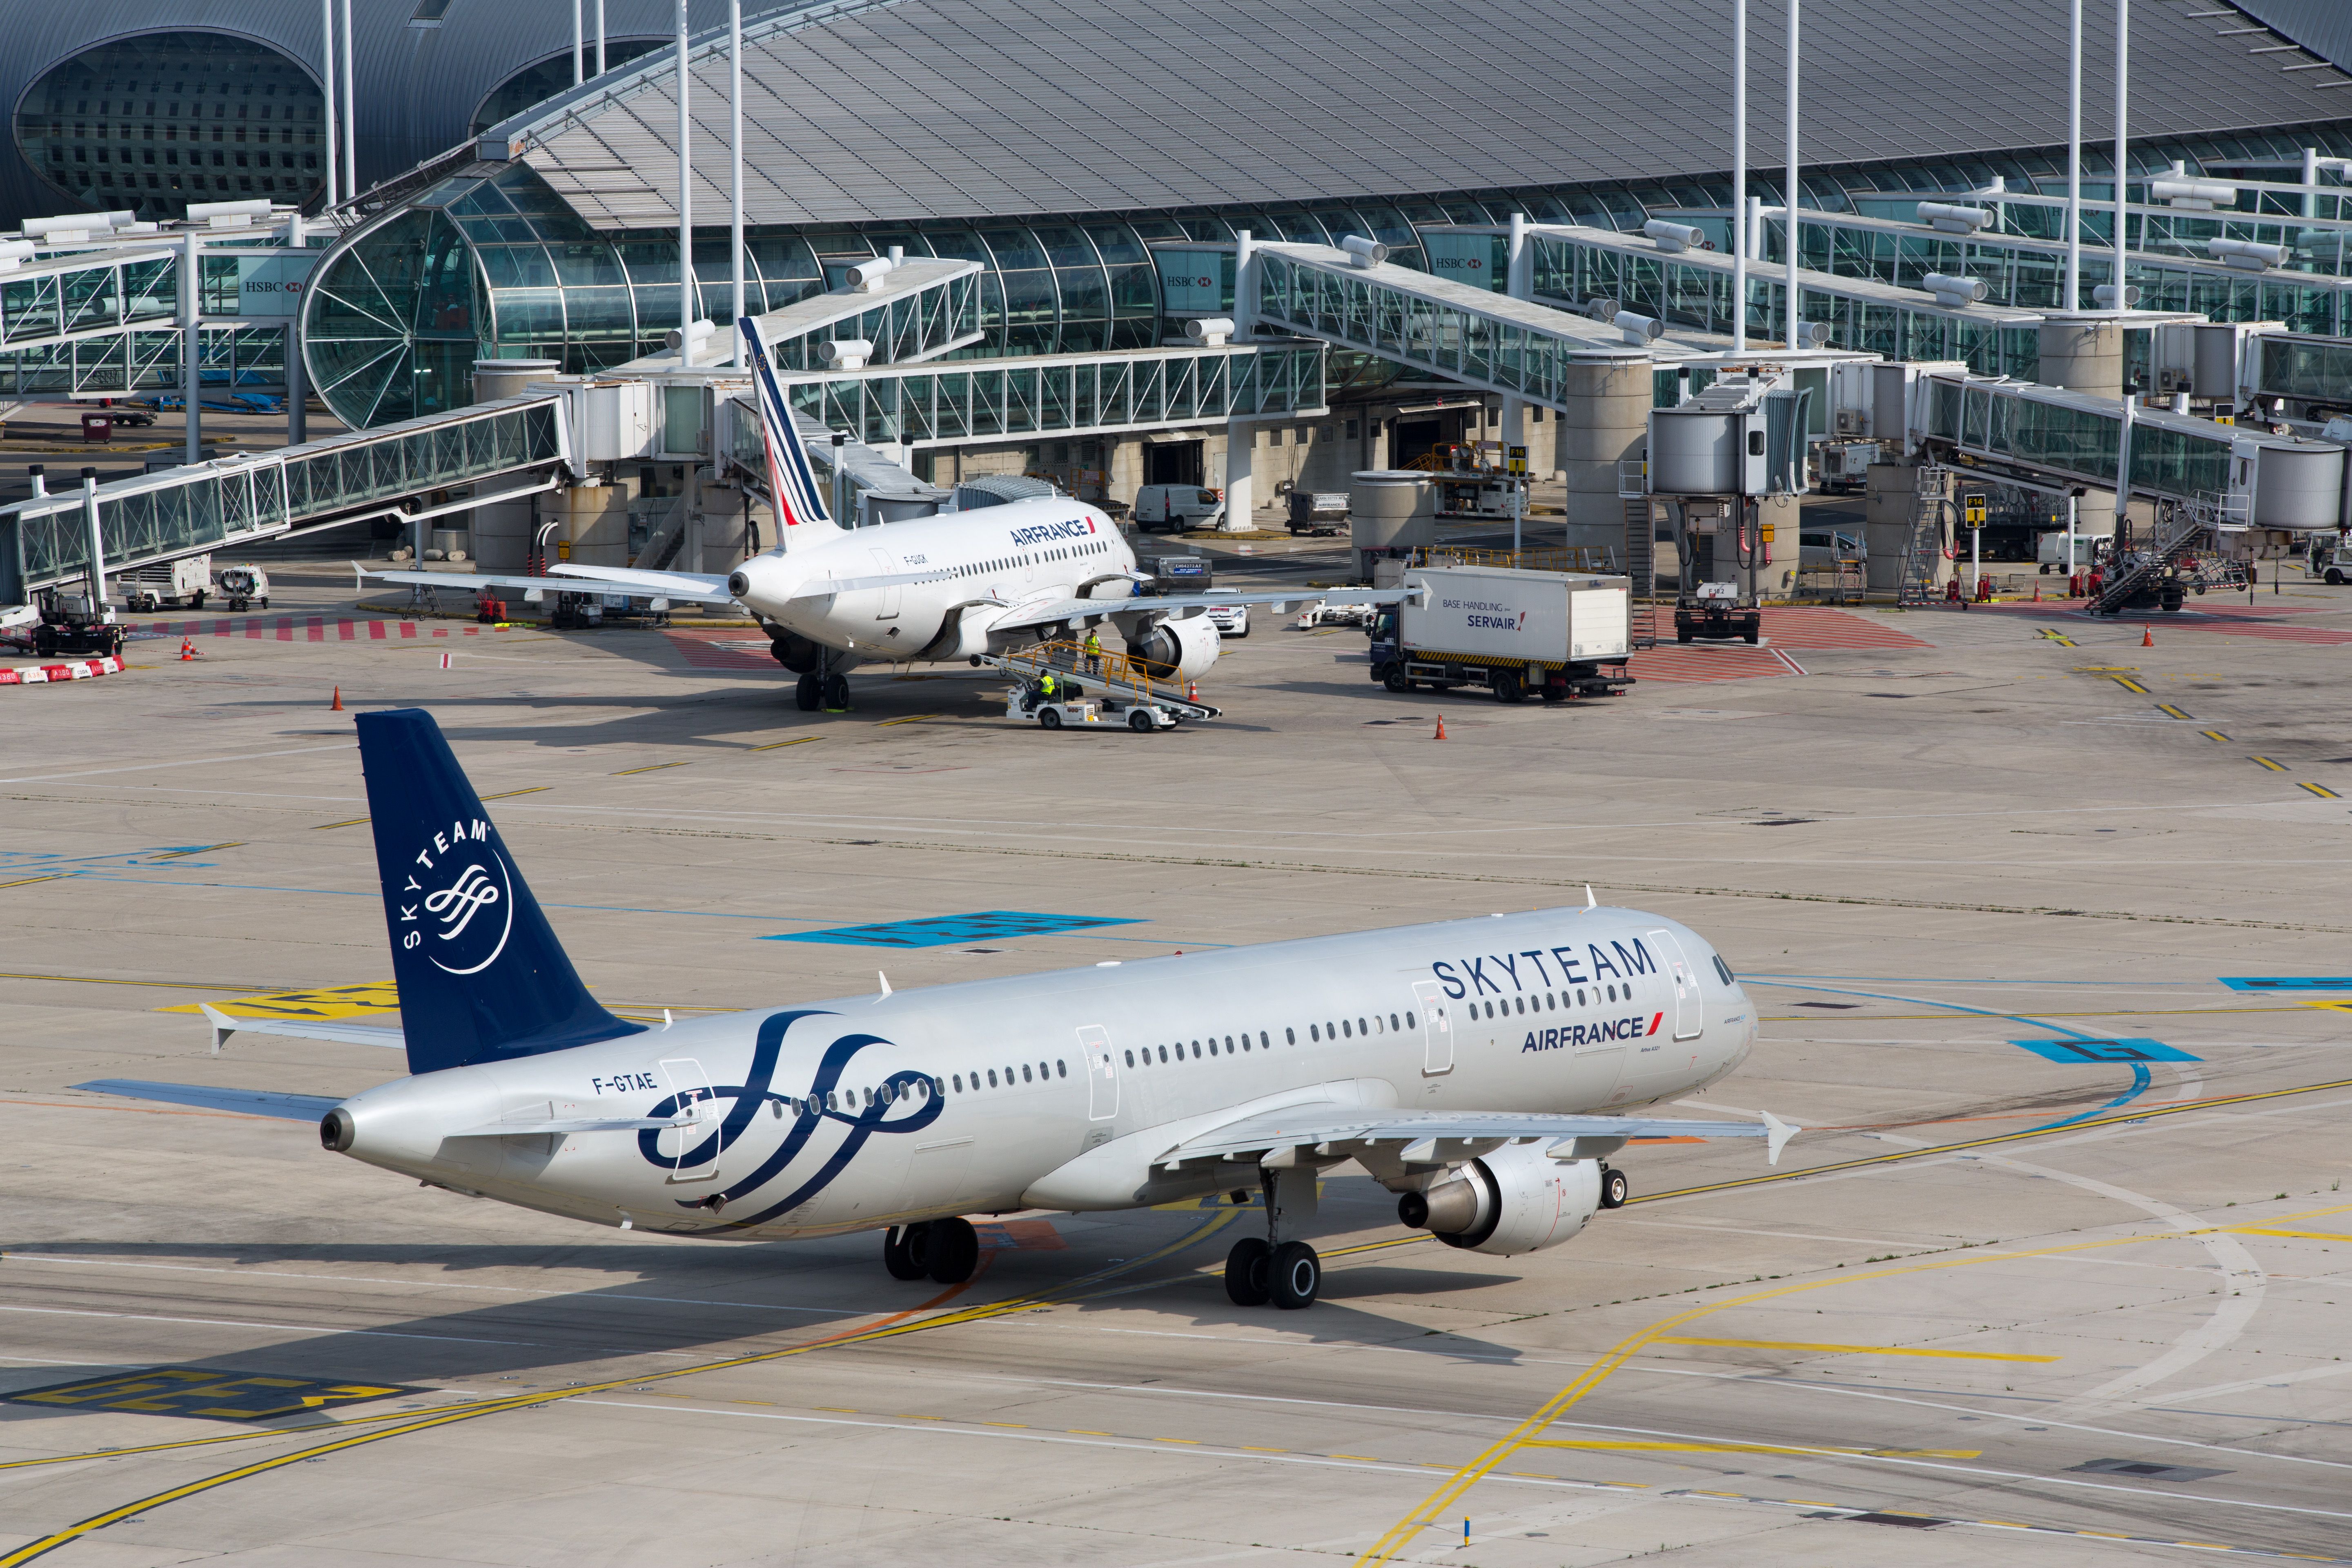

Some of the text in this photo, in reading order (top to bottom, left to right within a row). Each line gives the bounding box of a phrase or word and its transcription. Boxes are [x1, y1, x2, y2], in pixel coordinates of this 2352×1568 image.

[1436, 258, 1465, 269] HSBC
[245, 282, 283, 292] HSBC
[1167, 276, 1196, 287] HSBC
[1510, 448, 1524, 457] F16
[1968, 498, 1983, 506] F14
[1009, 519, 1088, 547] AIRFRANCE
[903, 553, 929, 566] F-GUGK
[1443, 599, 1461, 609] BASE
[1463, 600, 1503, 612] HANDLING
[1467, 614, 1516, 630] SERVAIR
[401, 819, 486, 949] SKYTEAM
[1432, 938, 1657, 1000] SKYTEAM
[1724, 1016, 1741, 1025] AIRFRANCE
[1521, 1016, 1644, 1054] AIRFRANCE
[591, 1072, 658, 1095] F-GTAE
